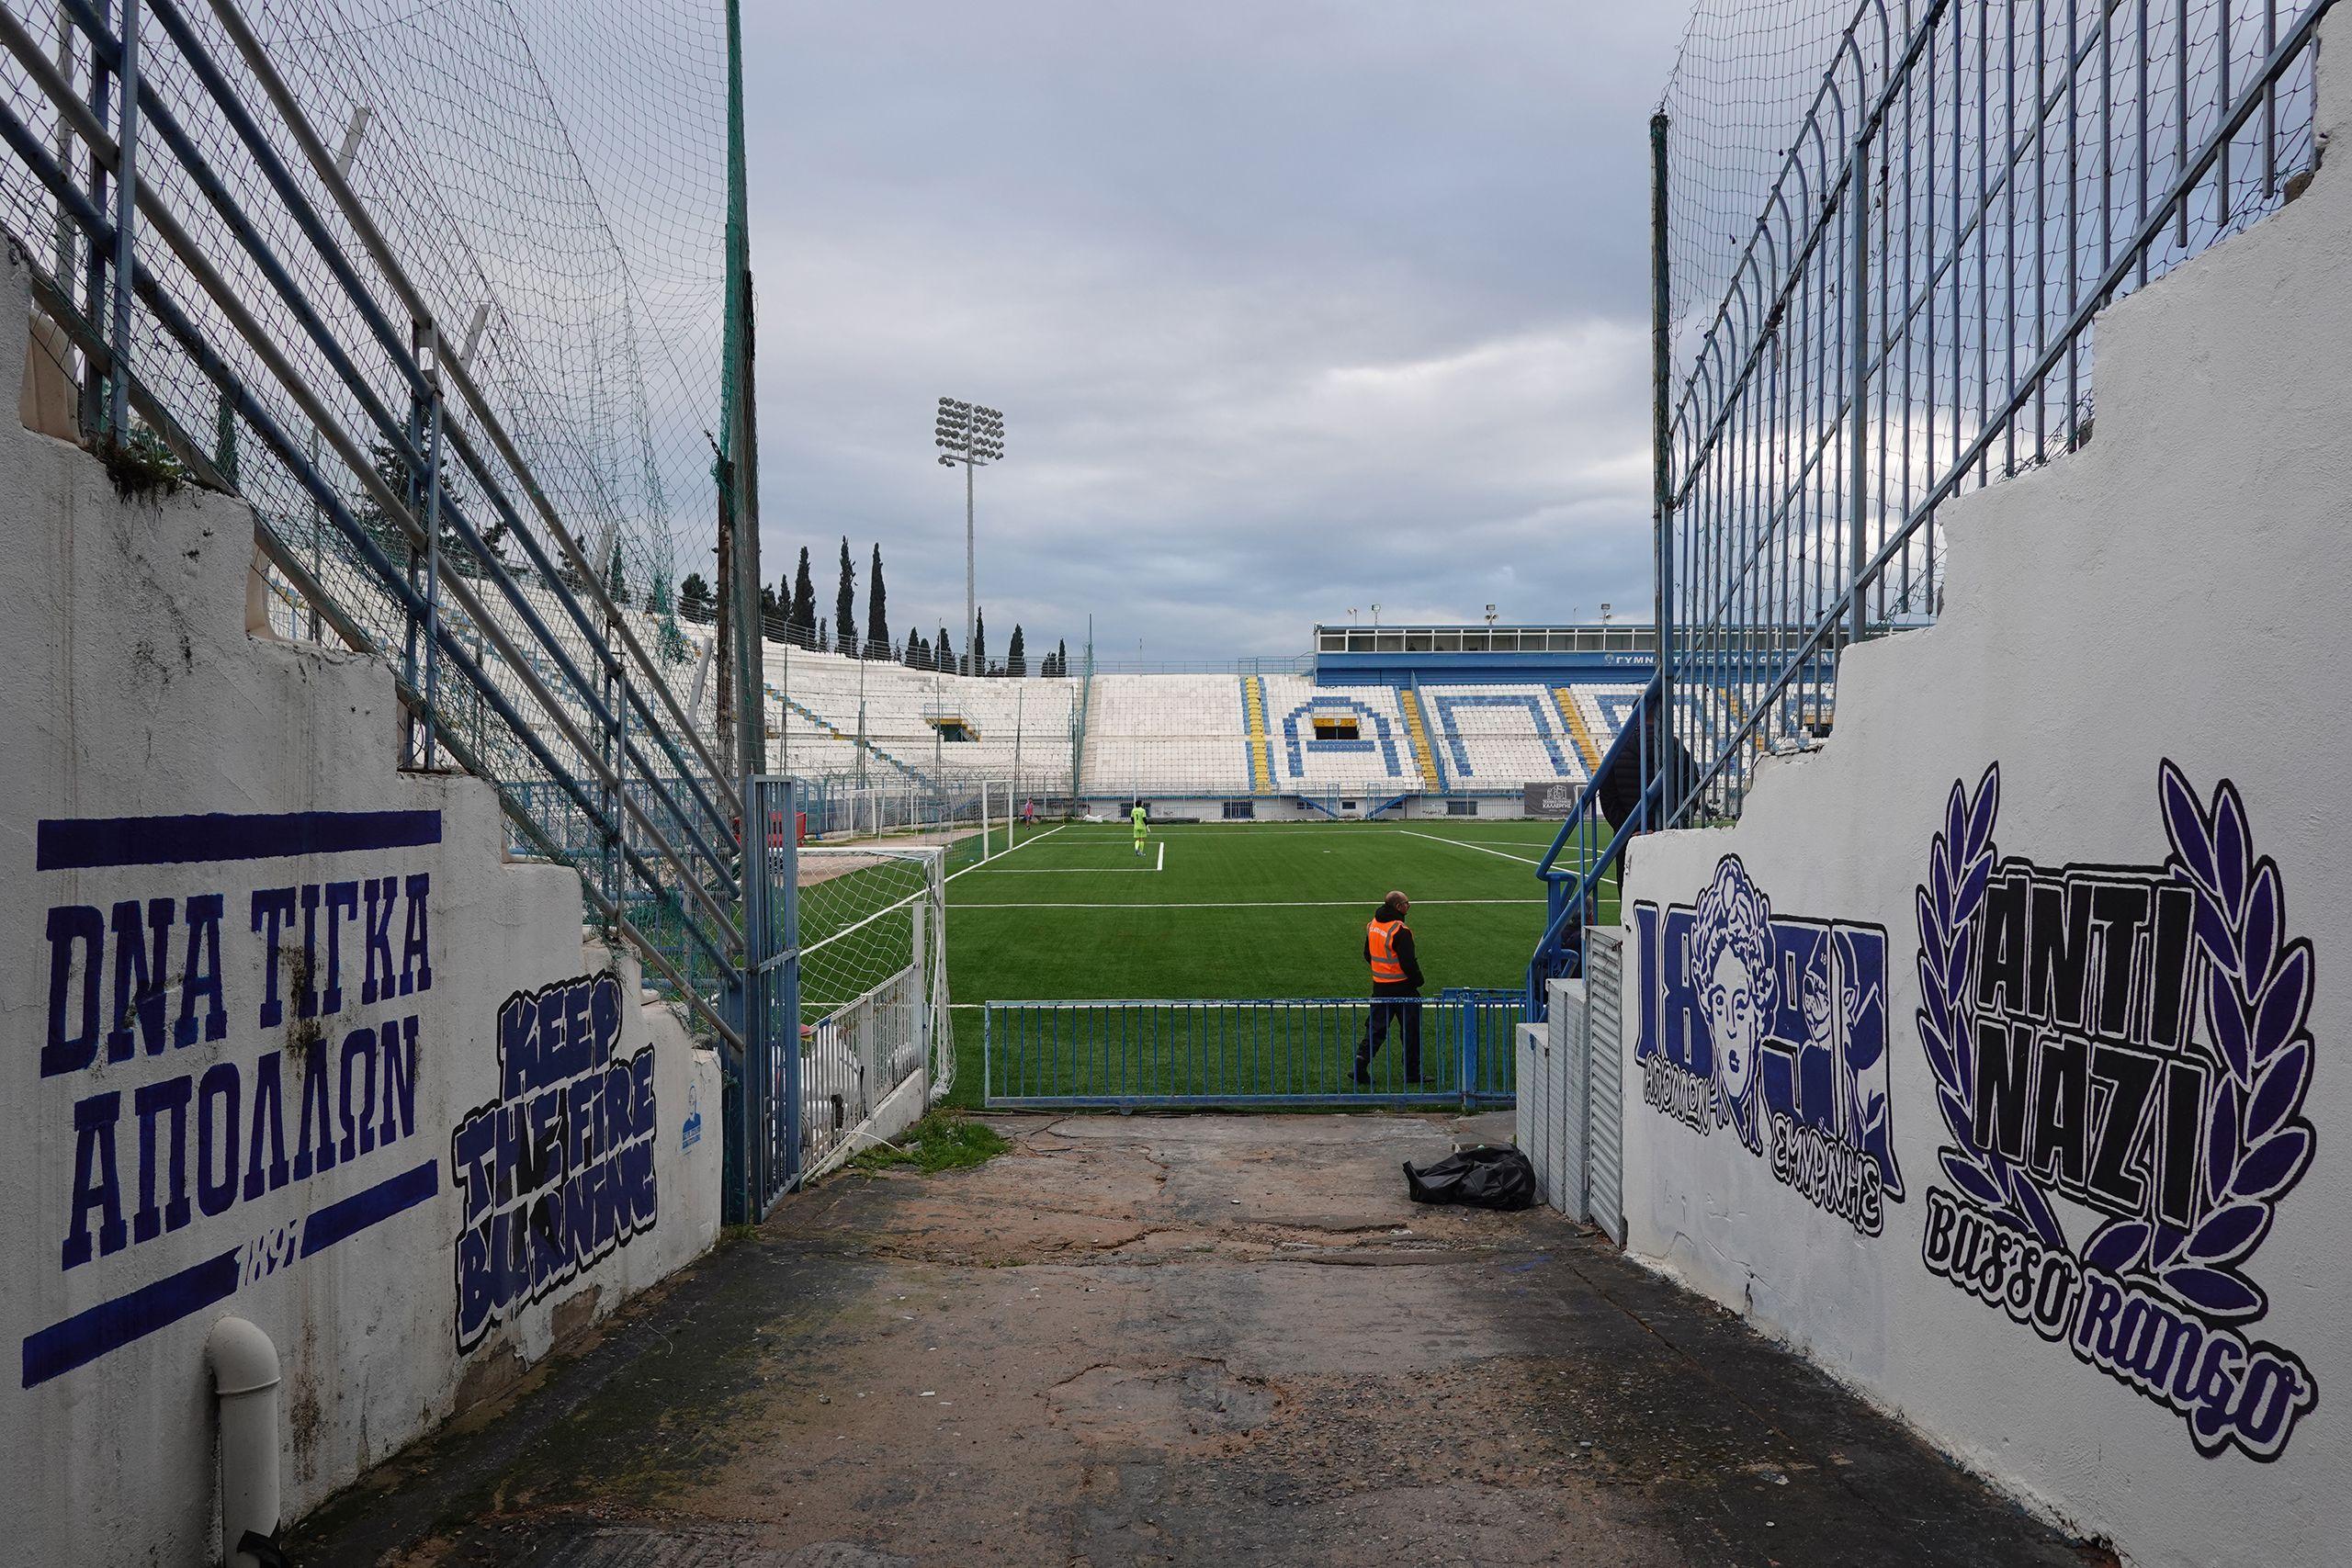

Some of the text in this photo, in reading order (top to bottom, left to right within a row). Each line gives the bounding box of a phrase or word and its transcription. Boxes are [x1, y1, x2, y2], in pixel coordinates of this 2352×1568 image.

[1722, 655, 1796, 663] ΣΥΛΟΓΟΣ
[40, 873, 431, 1078] DNA ΤΙΓΚΑ
[499, 973, 621, 1102] KEEP
[1976, 874, 2195, 1050] ANTI
[62, 1014, 419, 1271] ΑΠΟΛΛΩΝ
[455, 1050, 655, 1227] THE FIRE
[1973, 1018, 2206, 1229] NAZI
[234, 1219, 301, 1288] 1891
[457, 1138, 656, 1348] BURNING
